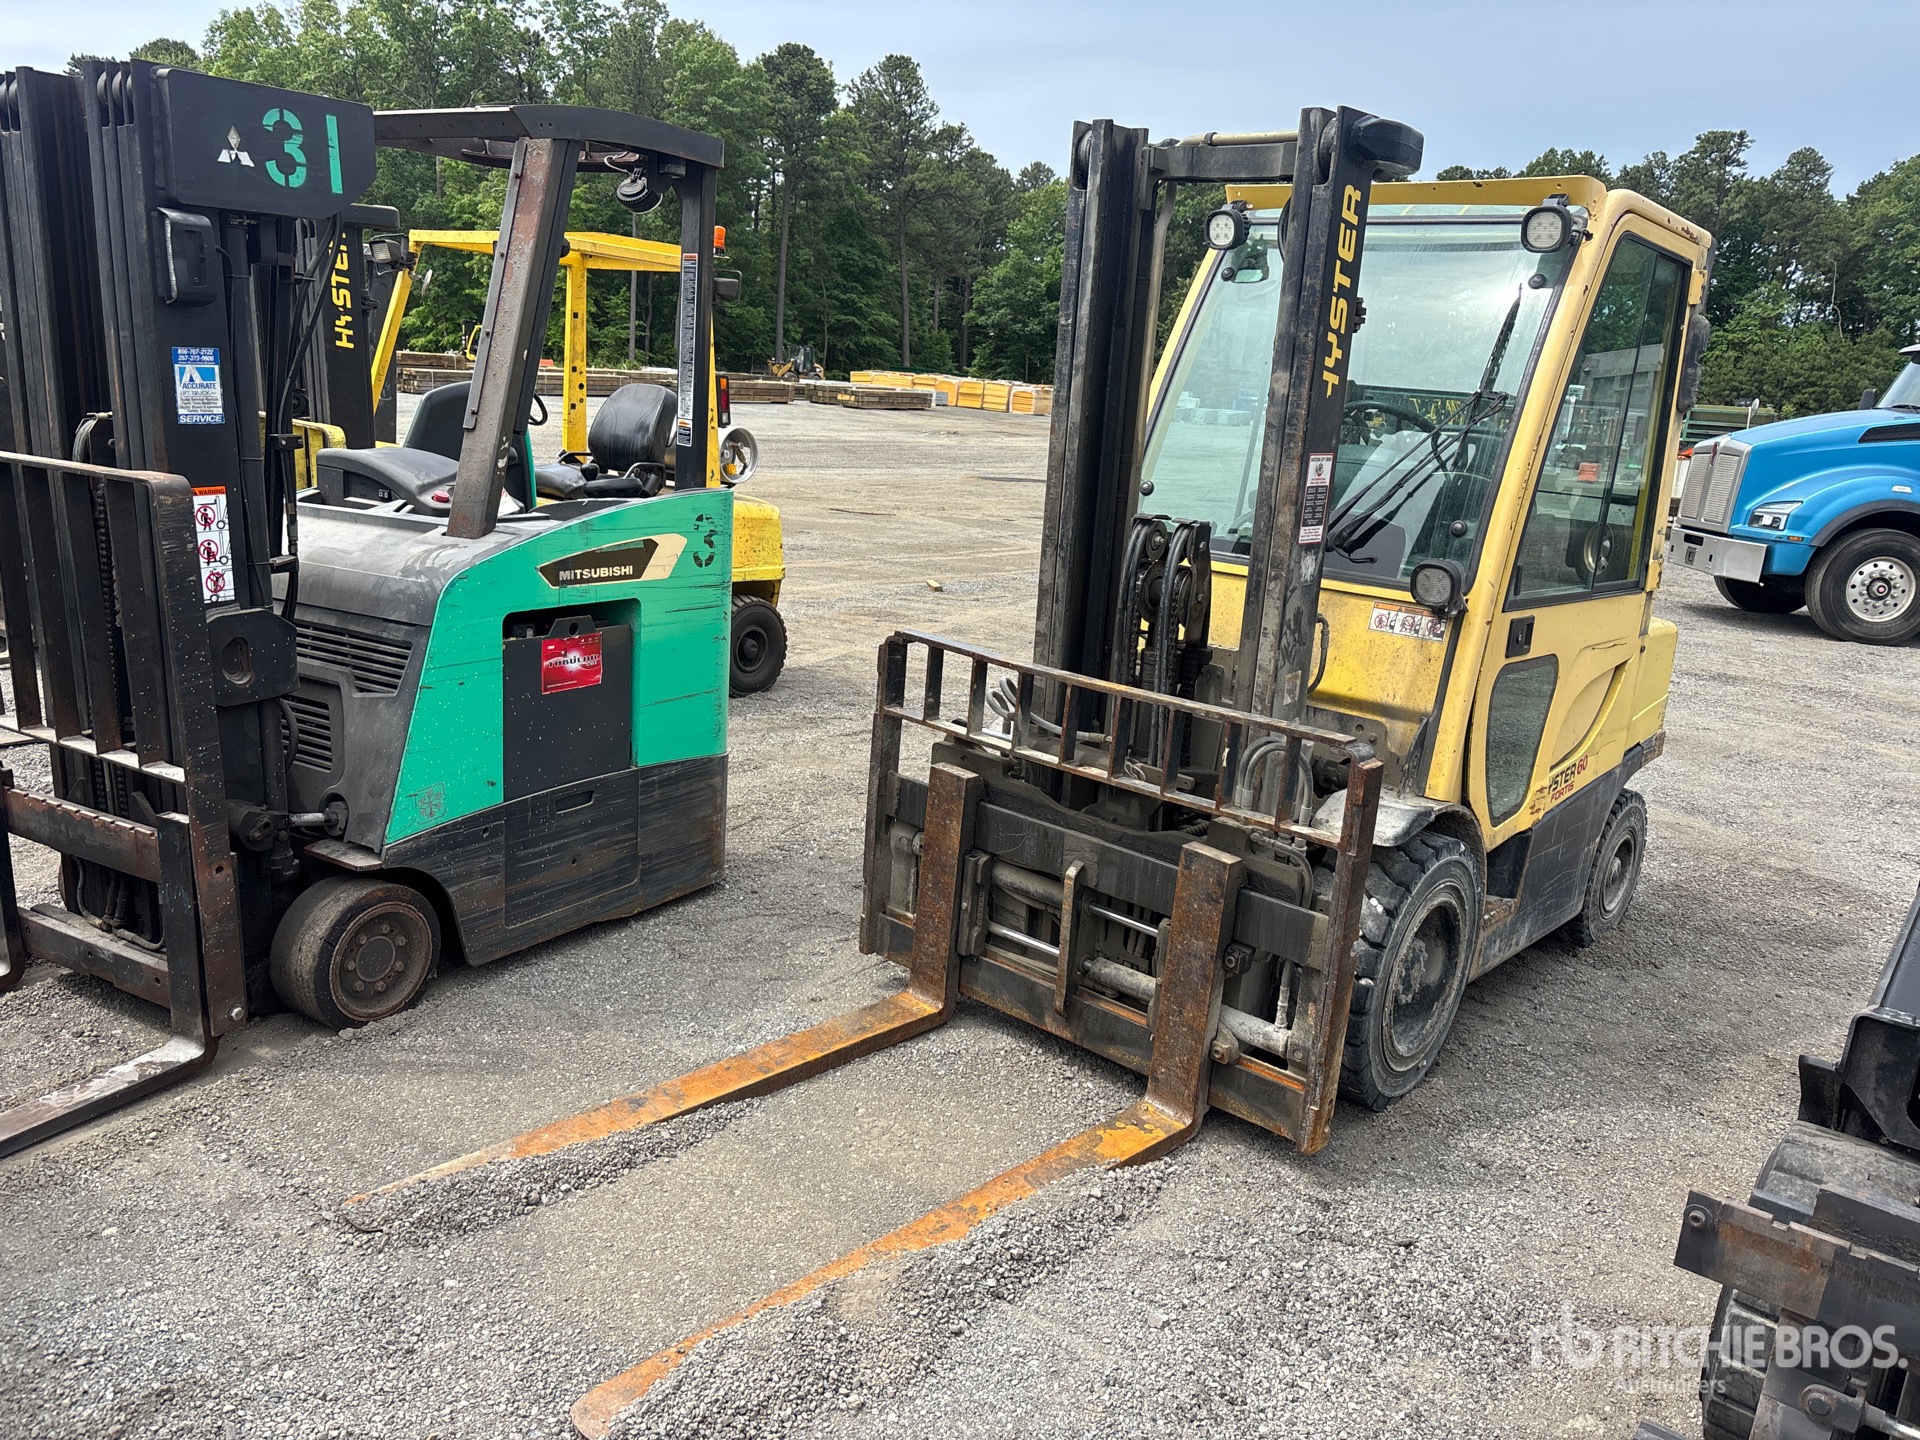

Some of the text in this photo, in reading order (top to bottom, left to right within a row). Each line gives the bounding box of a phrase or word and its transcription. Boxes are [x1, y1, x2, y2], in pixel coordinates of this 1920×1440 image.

[262, 107, 344, 194] 31
[182, 382, 217, 390] ACCURATE
[179, 414, 223, 423] SERVICE
[198, 488, 225, 496] WARNING
[559, 565, 633, 581] MITSUBISHI
[1576, 754, 1588, 776] 60
[1549, 780, 1575, 804] FORTIS
